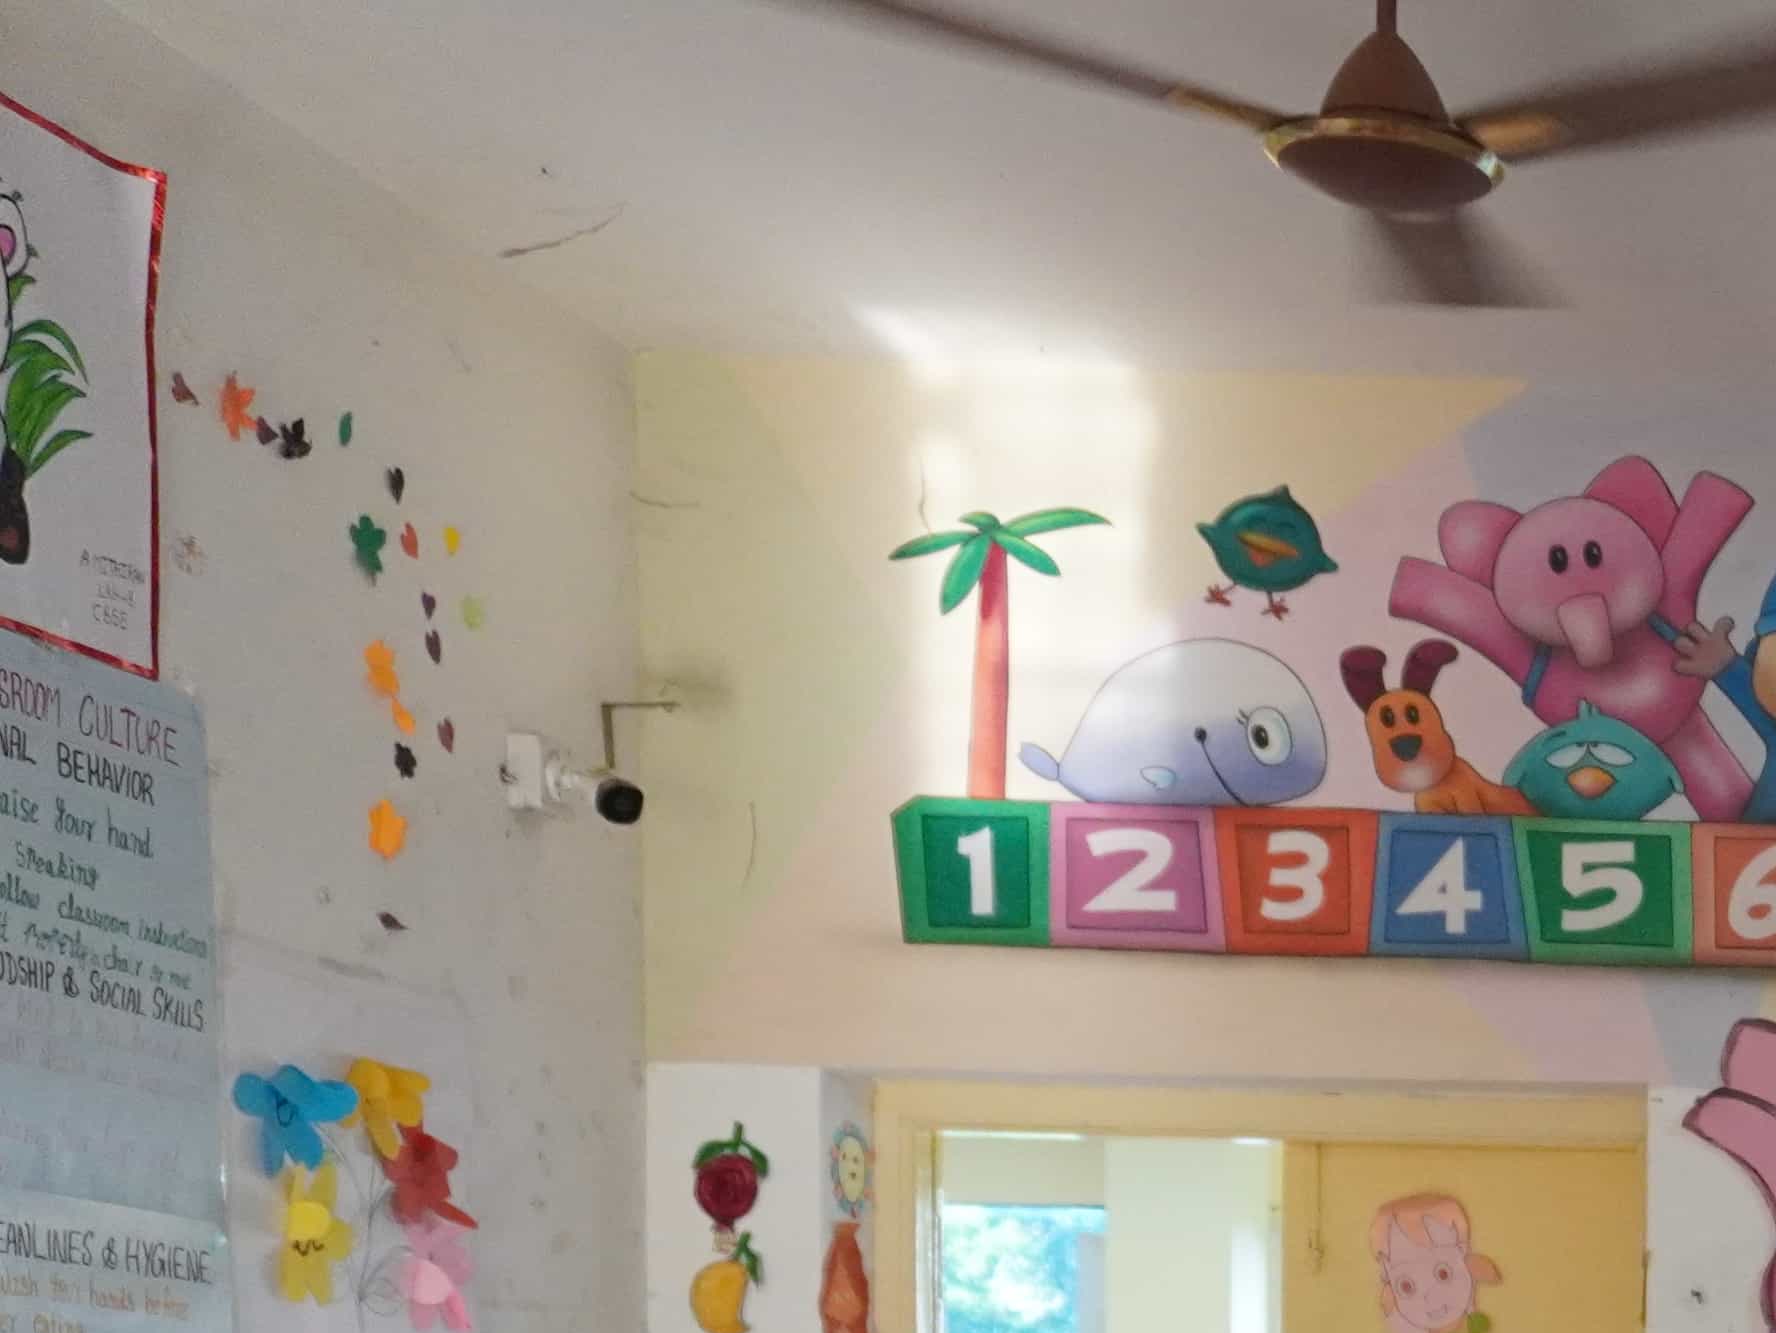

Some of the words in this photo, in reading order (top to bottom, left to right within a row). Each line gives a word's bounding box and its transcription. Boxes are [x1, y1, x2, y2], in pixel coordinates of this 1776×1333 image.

[78, 695, 182, 768] CULTURE
[57, 741, 155, 806] BEHAVIOR
[107, 805, 154, 859] hand
[957, 825, 994, 916] 1
[1082, 828, 1177, 912] 2
[1260, 829, 1330, 921] 3
[1396, 836, 1483, 935] 4
[1560, 841, 1644, 933] 5
[90, 970, 146, 1017] SOCIAL
[152, 987, 204, 1033] SKILLS
[126, 1238, 213, 1286] HYGIENE
